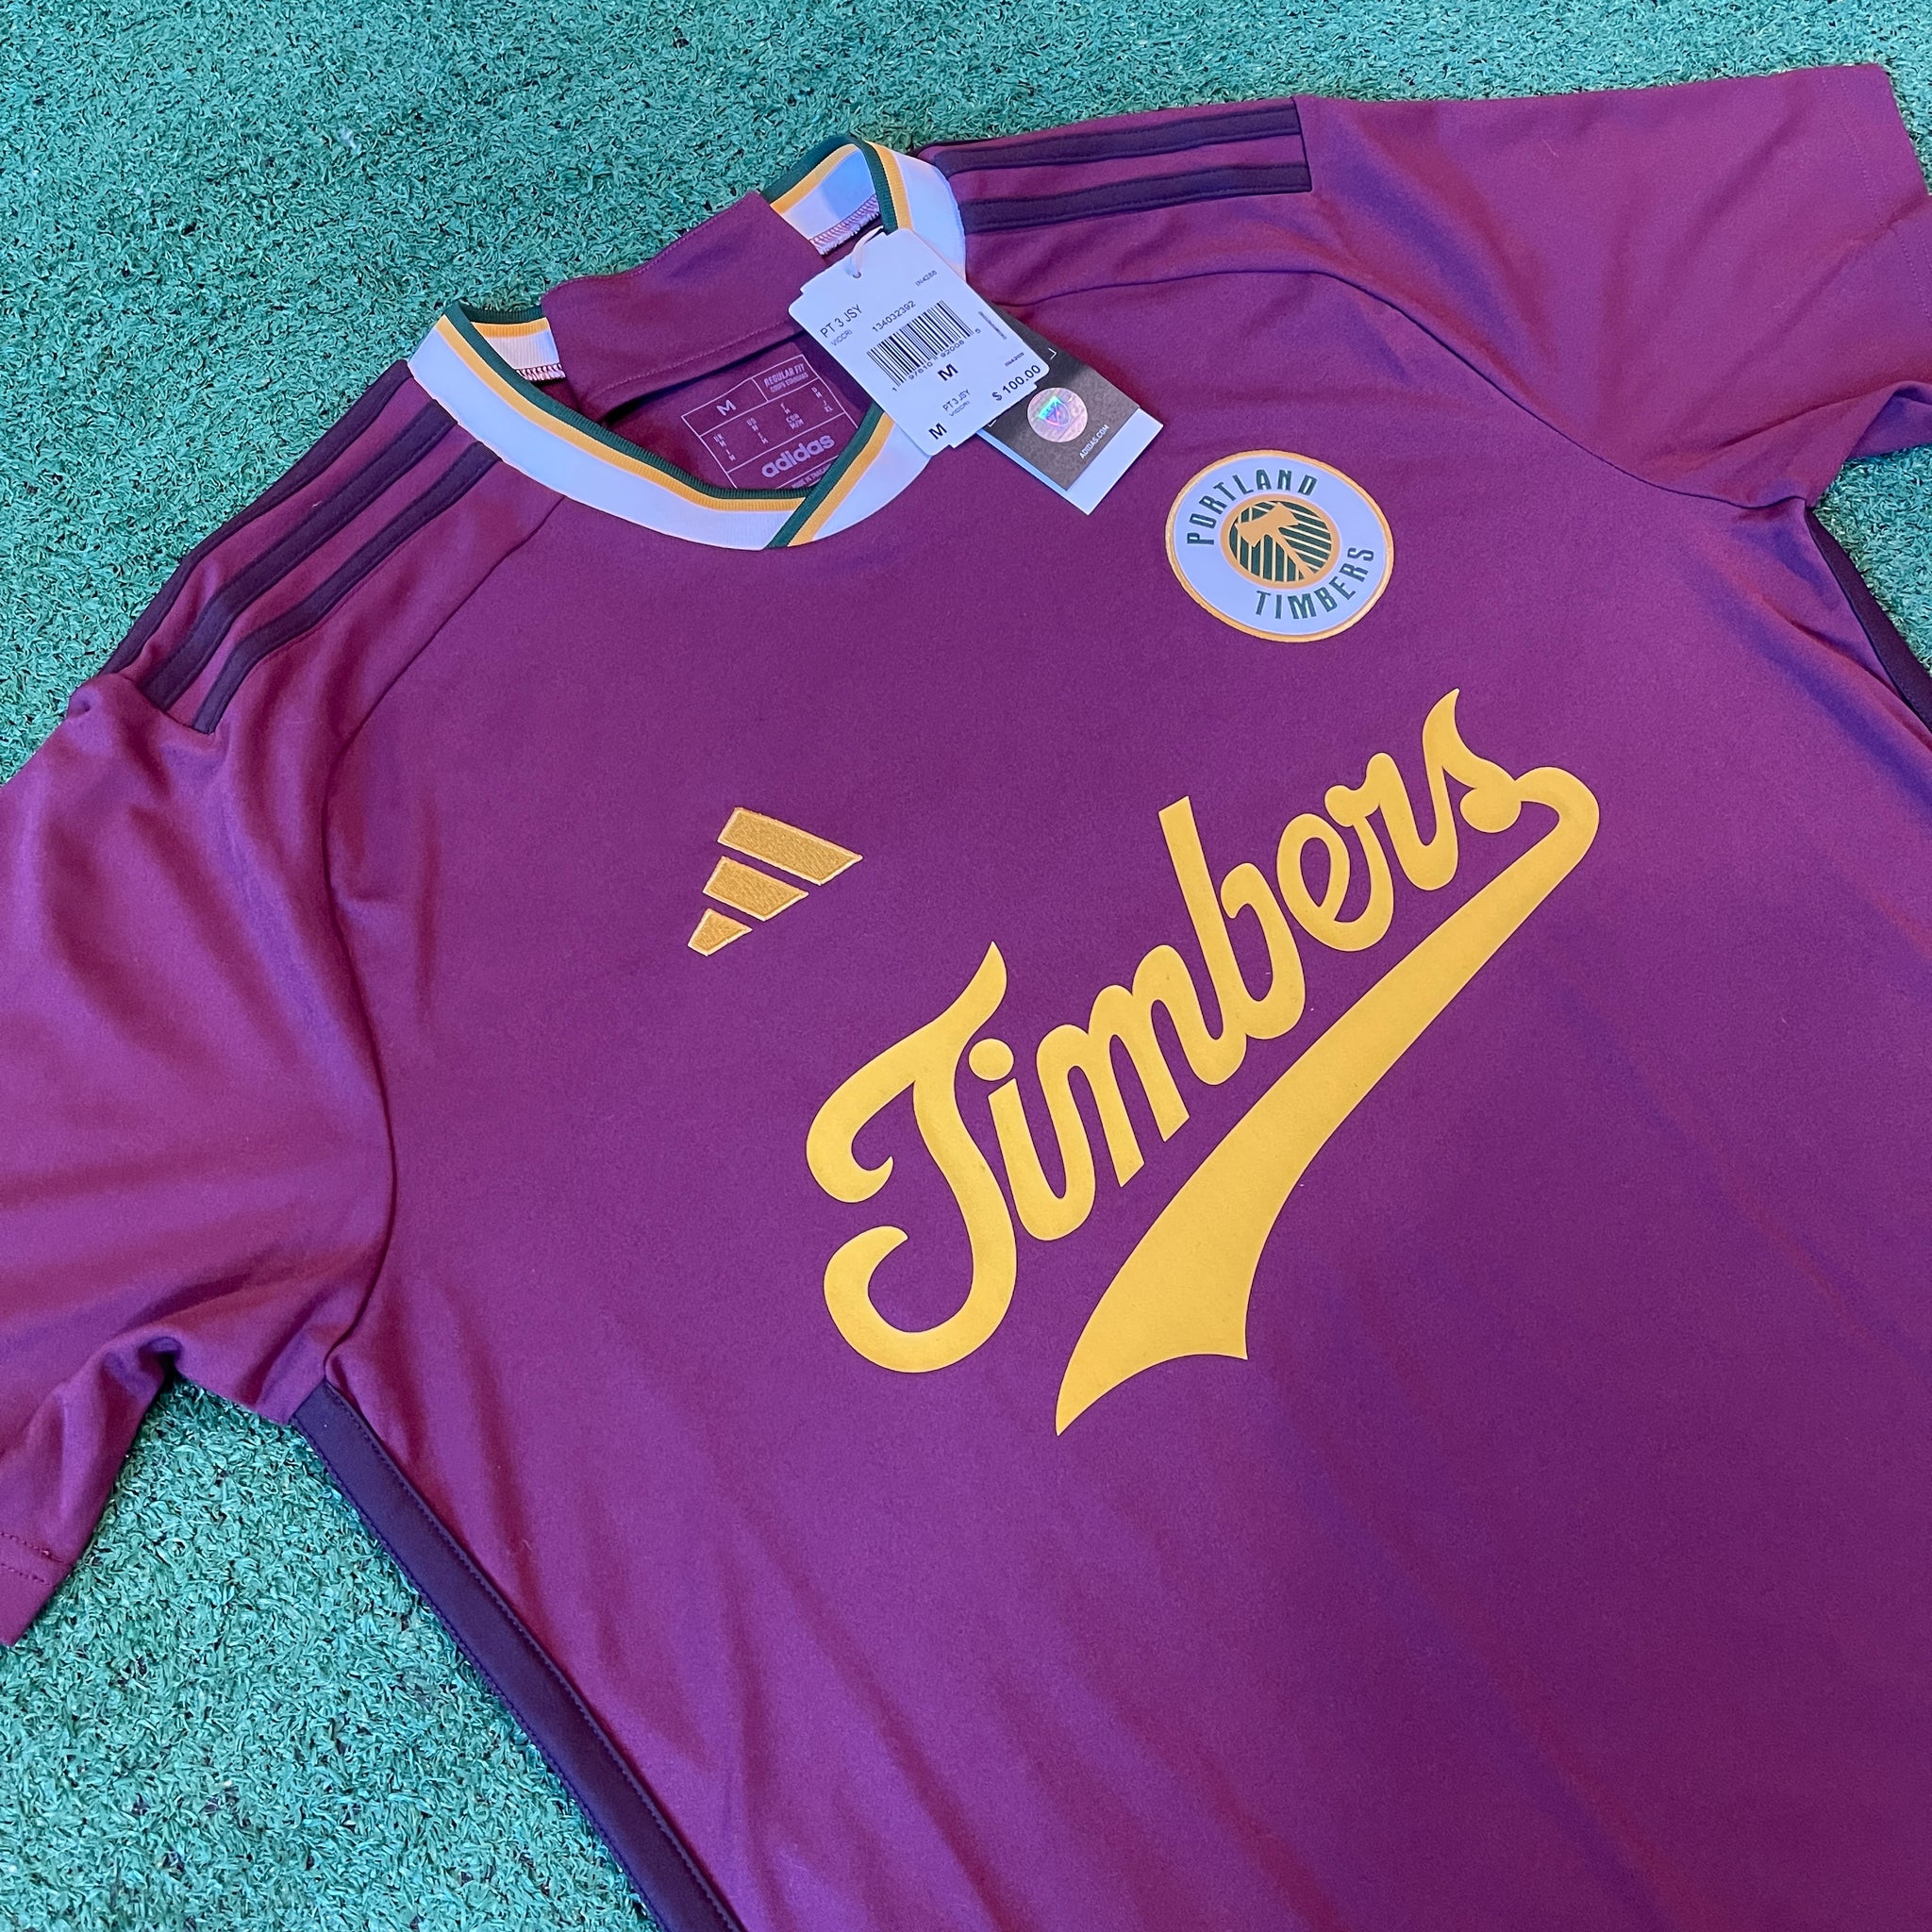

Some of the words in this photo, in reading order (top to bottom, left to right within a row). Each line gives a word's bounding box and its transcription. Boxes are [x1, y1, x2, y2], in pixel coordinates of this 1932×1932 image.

[820, 323, 836, 339] PT
[834, 318, 844, 327] 3
[843, 304, 862, 323] JSY
[872, 300, 916, 332] 134032392
[764, 367, 795, 387] REGULAR
[794, 363, 806, 375] FIT
[937, 363, 958, 381] M
[991, 391, 1002, 402] $
[1002, 364, 1041, 394] 100.00
[716, 399, 737, 416] M
[942, 401, 954, 411] PT
[958, 389, 971, 401] JSY
[928, 423, 947, 440] M
[1079, 425, 1110, 459] ADIDAS.COM
[761, 435, 835, 477] adidas
[1187, 469, 1318, 545] PORTLAND
[1255, 547, 1374, 620] TIMBERS
[807, 689, 1533, 1374] Timbers
